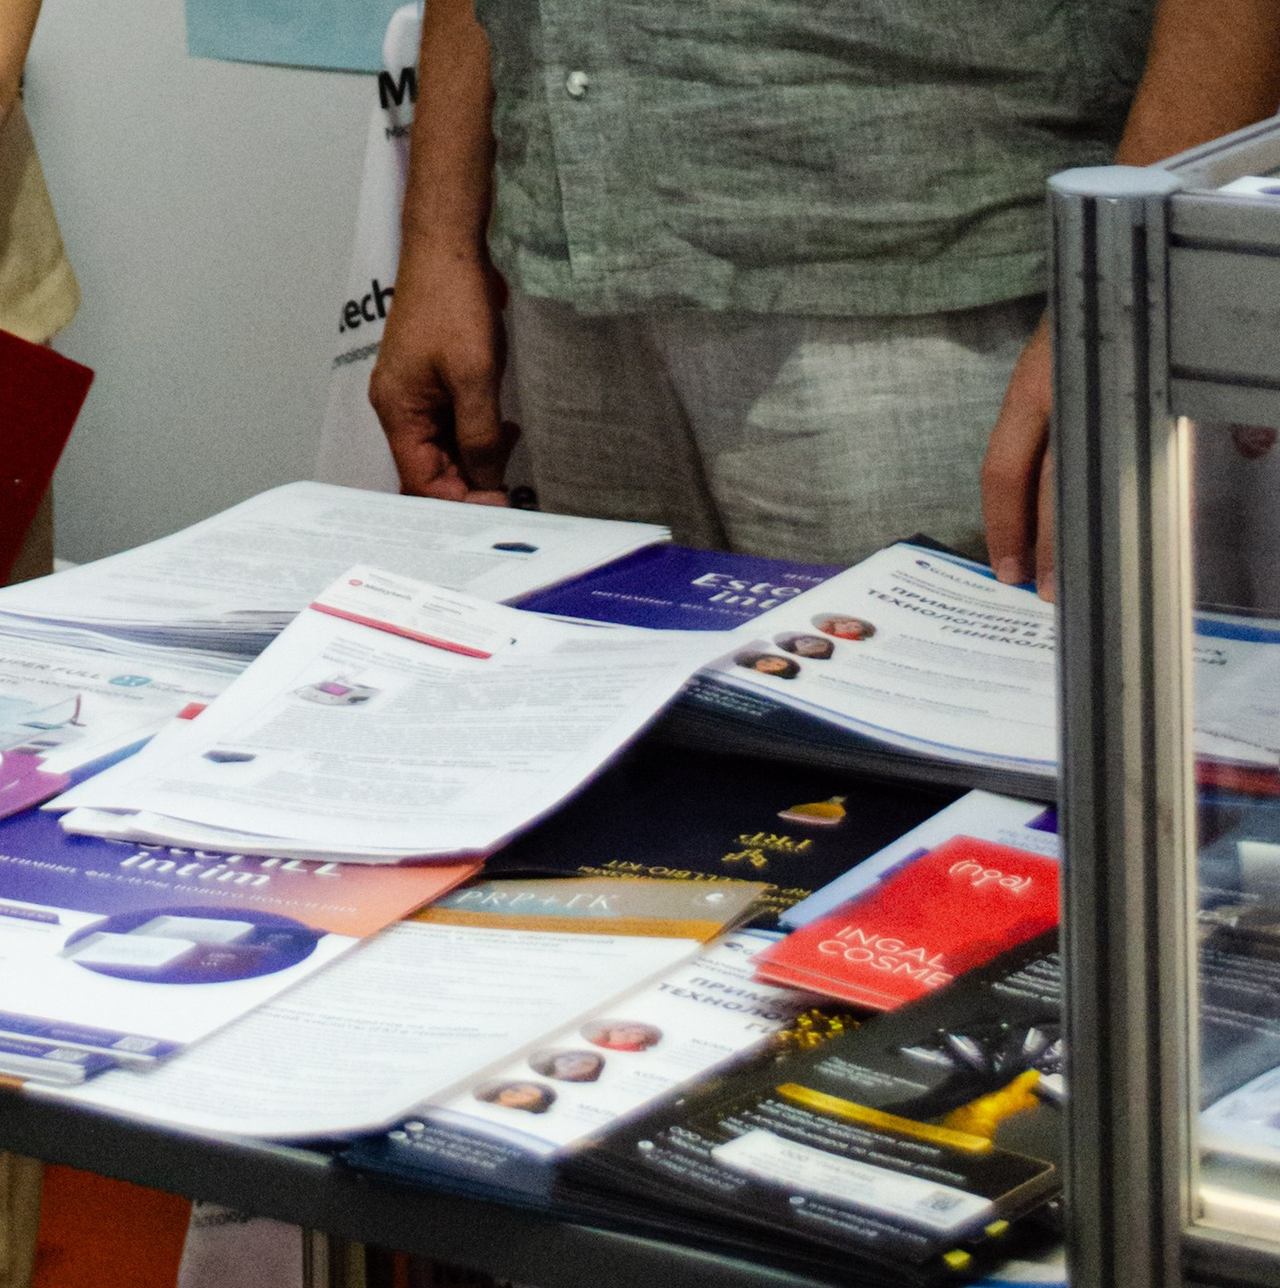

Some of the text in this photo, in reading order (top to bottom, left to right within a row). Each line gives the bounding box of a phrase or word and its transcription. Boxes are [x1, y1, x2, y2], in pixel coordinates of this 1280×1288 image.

[119, 851, 271, 887] intim
[818, 939, 954, 988] COSME
[836, 925, 947, 970] INGAL
